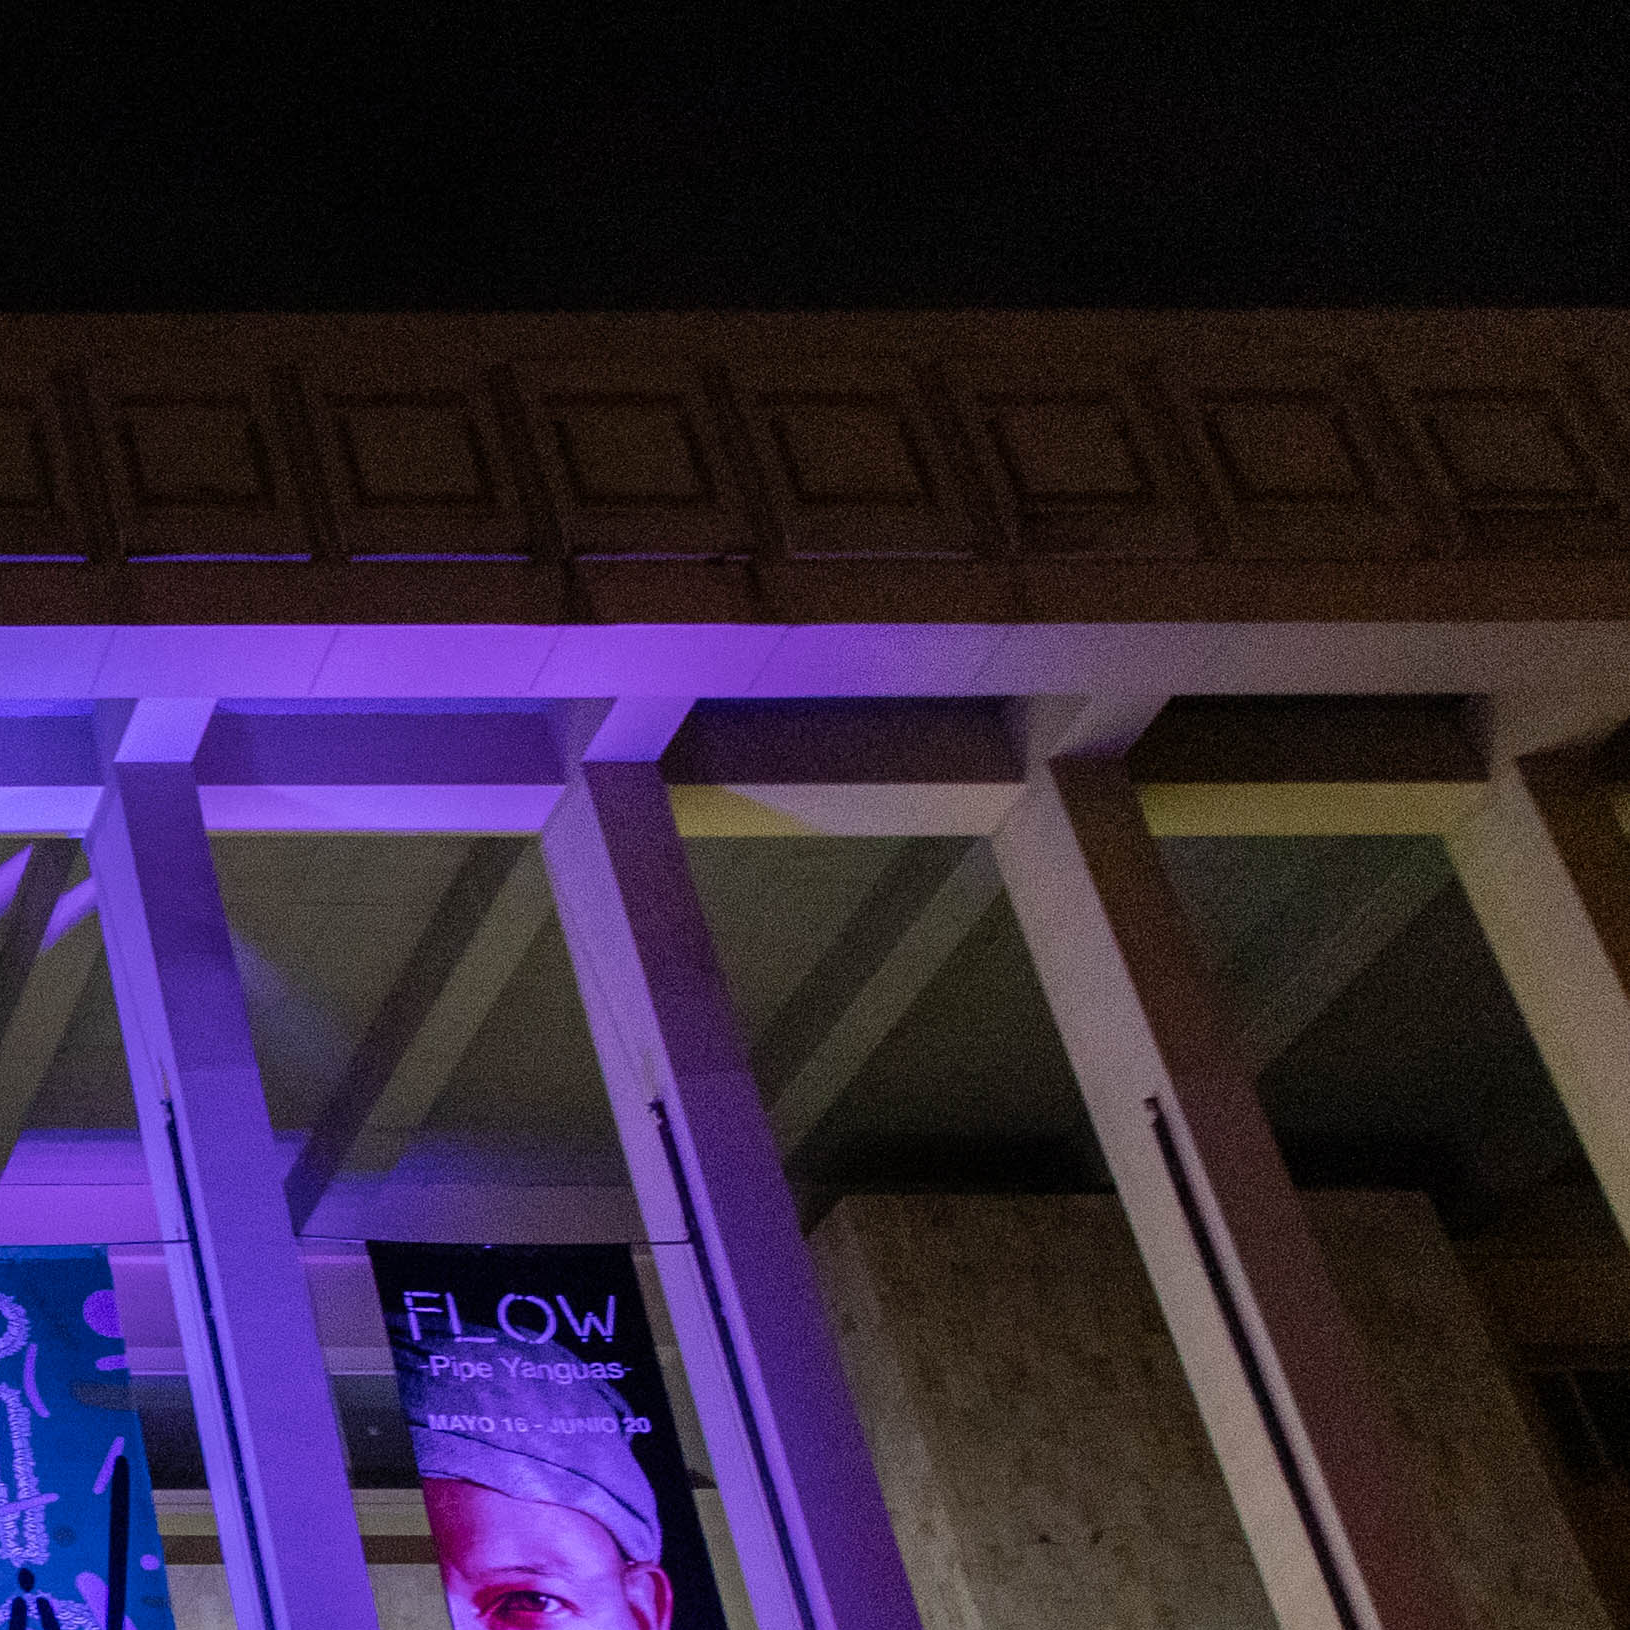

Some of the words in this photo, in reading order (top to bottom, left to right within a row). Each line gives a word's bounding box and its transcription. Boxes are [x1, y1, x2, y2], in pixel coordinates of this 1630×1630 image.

[403, 1290, 617, 1345] FLOW
[427, 1414, 496, 1433] MAYO
[504, 1415, 529, 1432] 16
[550, 1416, 619, 1435] JUNIO
[622, 1416, 652, 1434] 20
